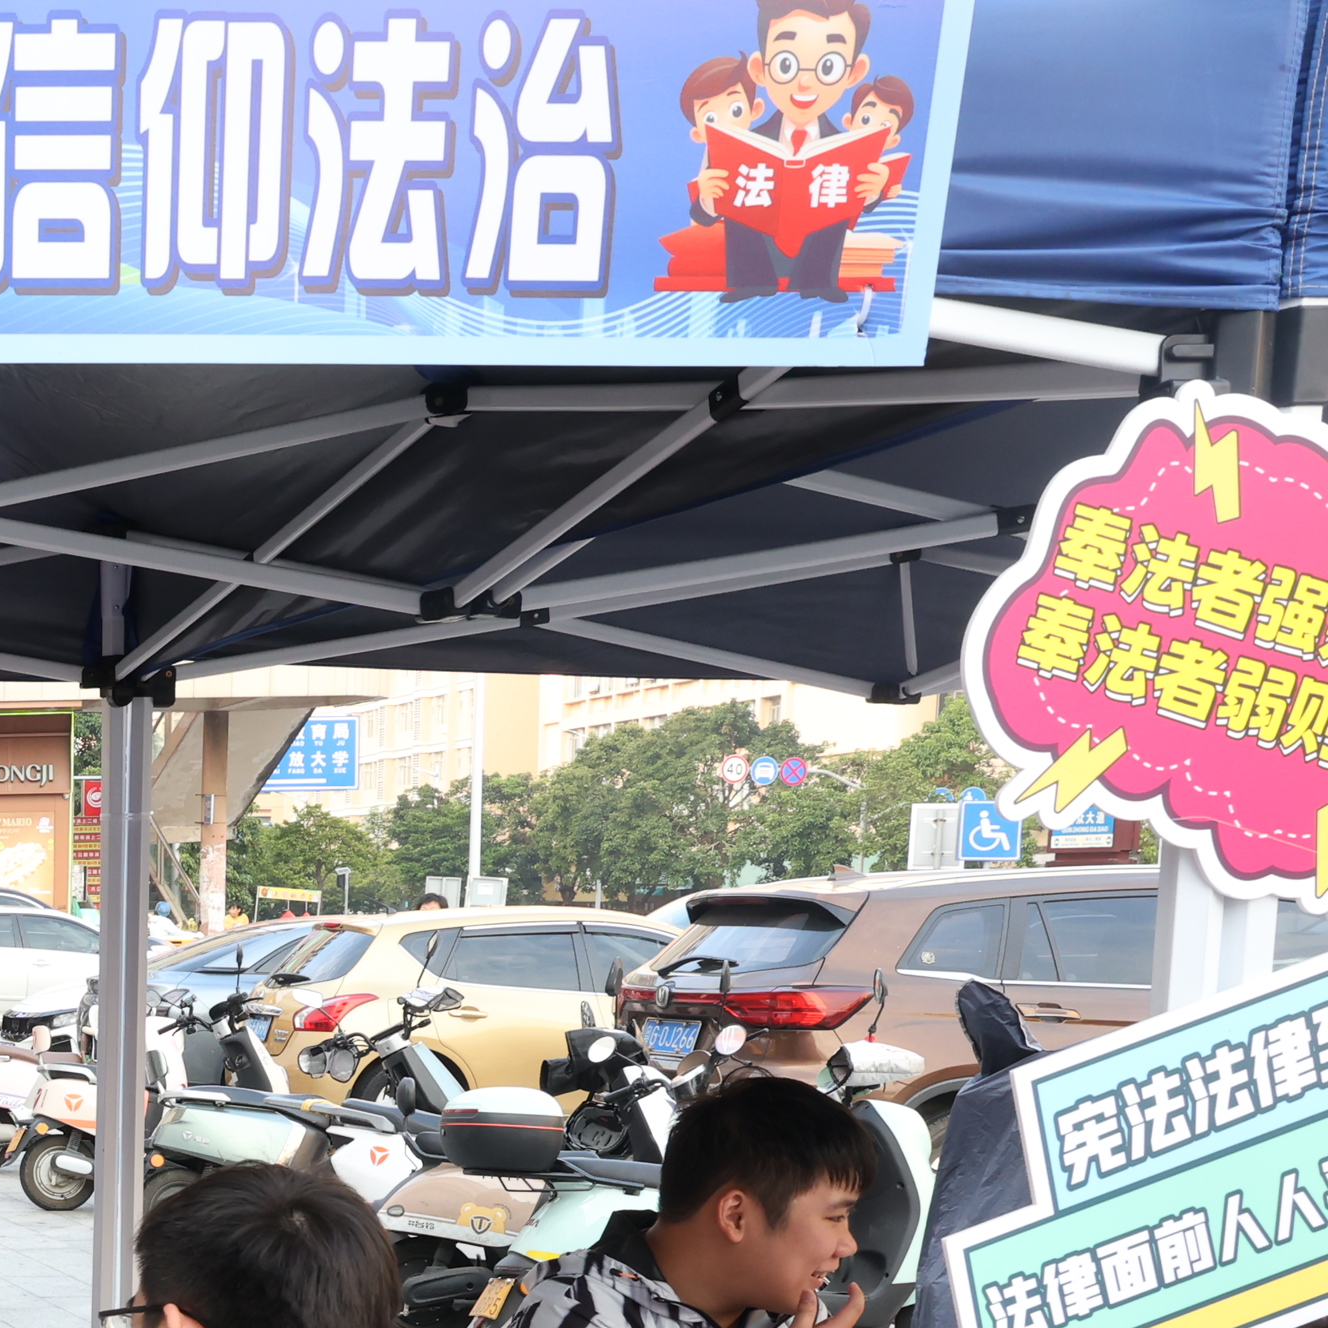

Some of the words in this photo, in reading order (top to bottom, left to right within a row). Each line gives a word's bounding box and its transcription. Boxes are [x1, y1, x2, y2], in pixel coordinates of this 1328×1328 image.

[733, 162, 850, 209] 法律
[1053, 502, 1328, 667] 奉法者强
[2, 816, 33, 827] MARIO
[1056, 1008, 1328, 1186] 宪法法律
